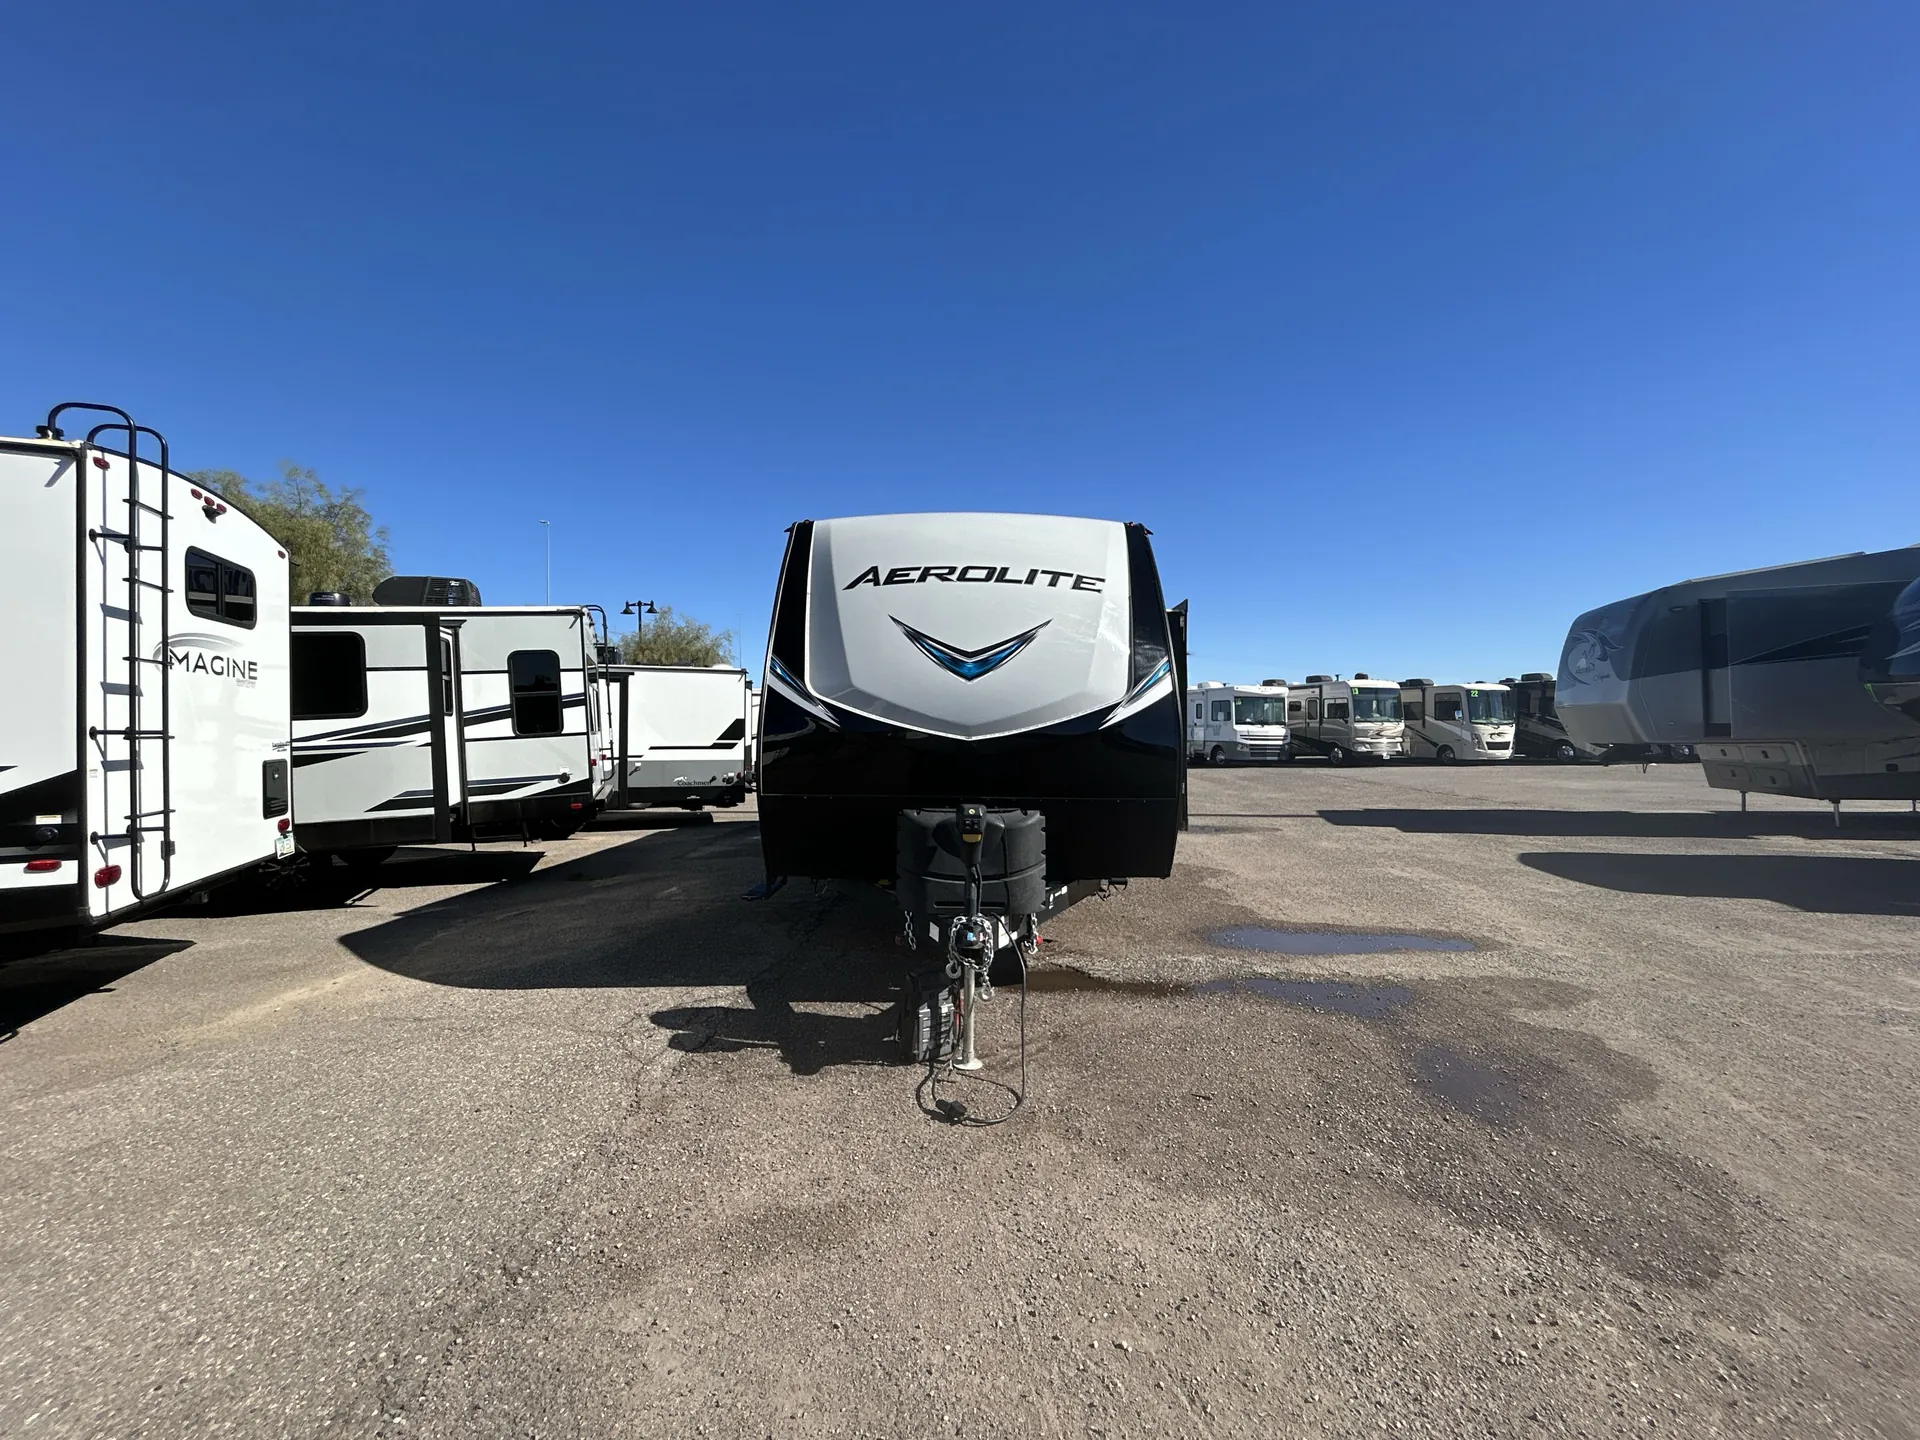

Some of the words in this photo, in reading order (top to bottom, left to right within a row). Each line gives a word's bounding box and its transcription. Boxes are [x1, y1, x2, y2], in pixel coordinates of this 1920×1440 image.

[841, 565, 1106, 594] AEROLITE
[163, 648, 258, 681] MAGINE
[1470, 689, 1479, 698] 22
